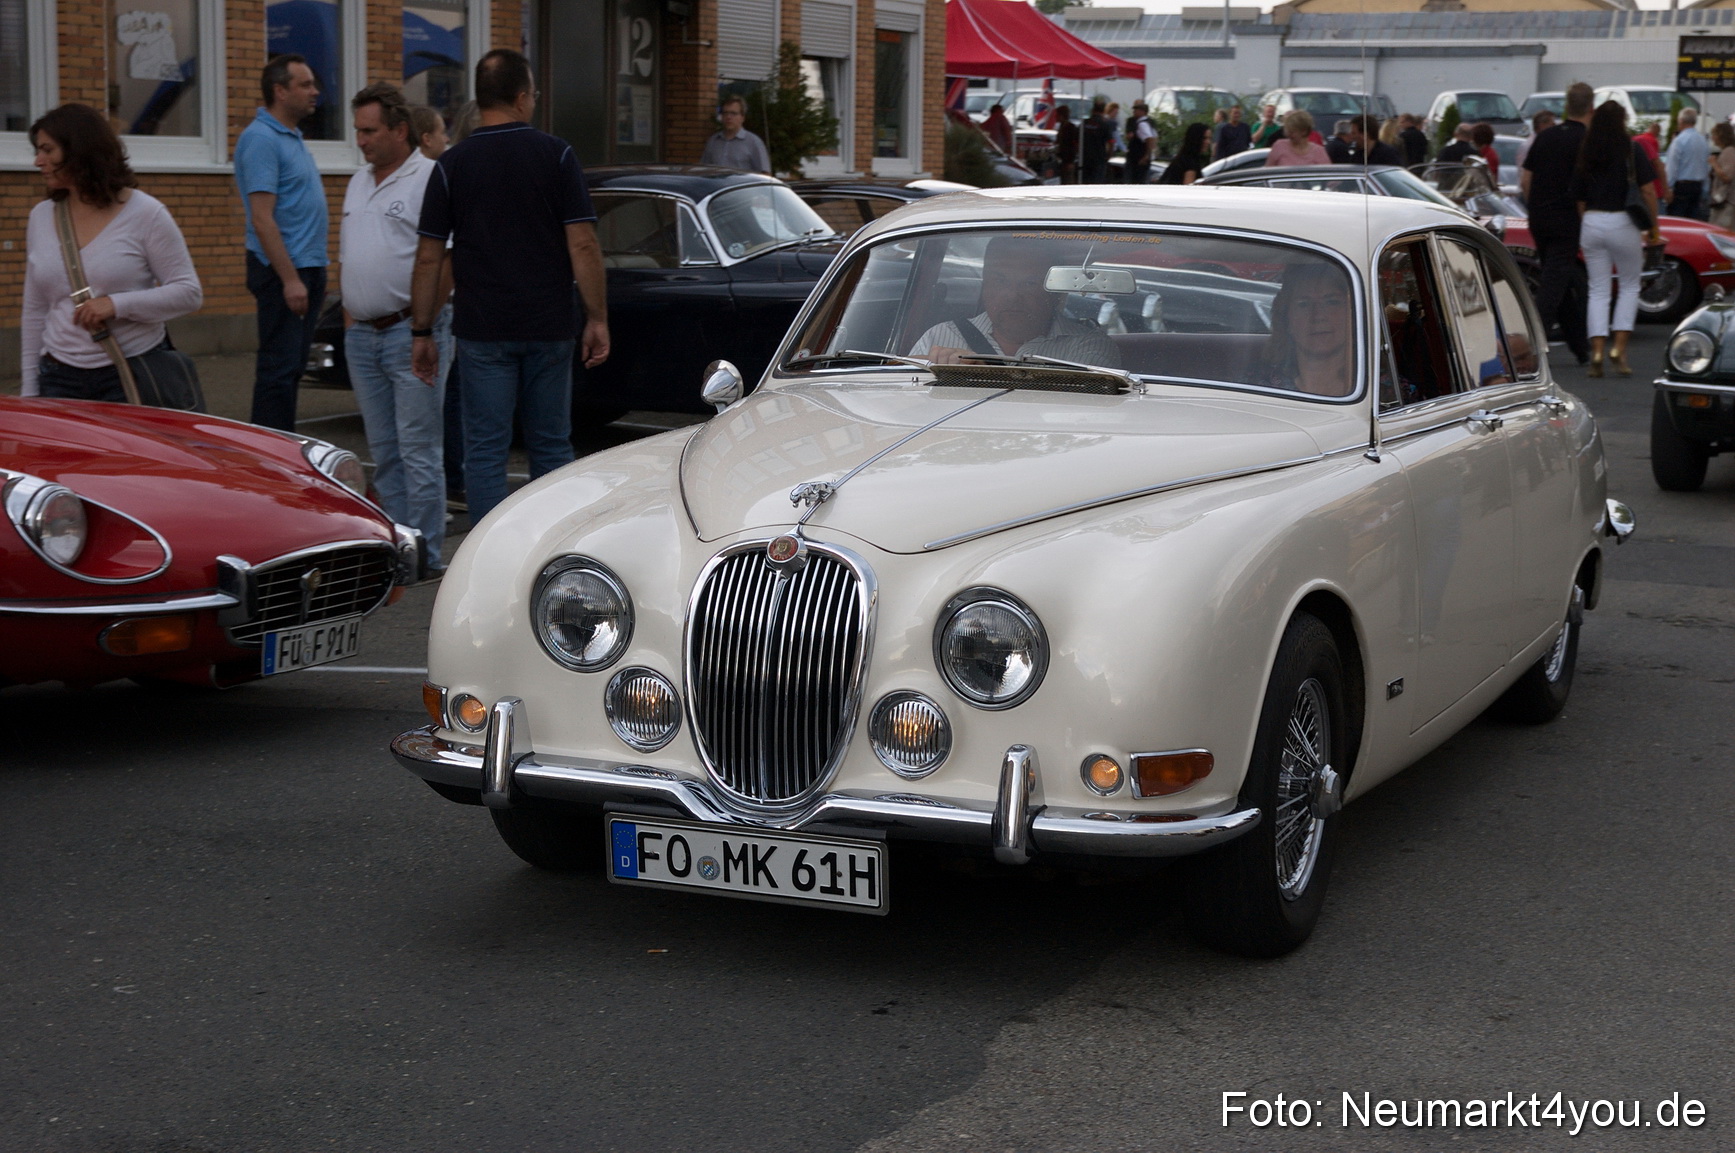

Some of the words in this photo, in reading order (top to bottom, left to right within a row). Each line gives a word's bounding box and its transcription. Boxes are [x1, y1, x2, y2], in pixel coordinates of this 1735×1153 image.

[617, 17, 654, 77] 12
[1012, 231, 1163, 244] www.Schmetterling-Laden.de
[279, 632, 302, 668] FÜ
[313, 629, 325, 661] F
[621, 855, 630, 868] D
[637, 831, 692, 878] FO
[722, 840, 779, 888] MK
[791, 849, 876, 900] 61H
